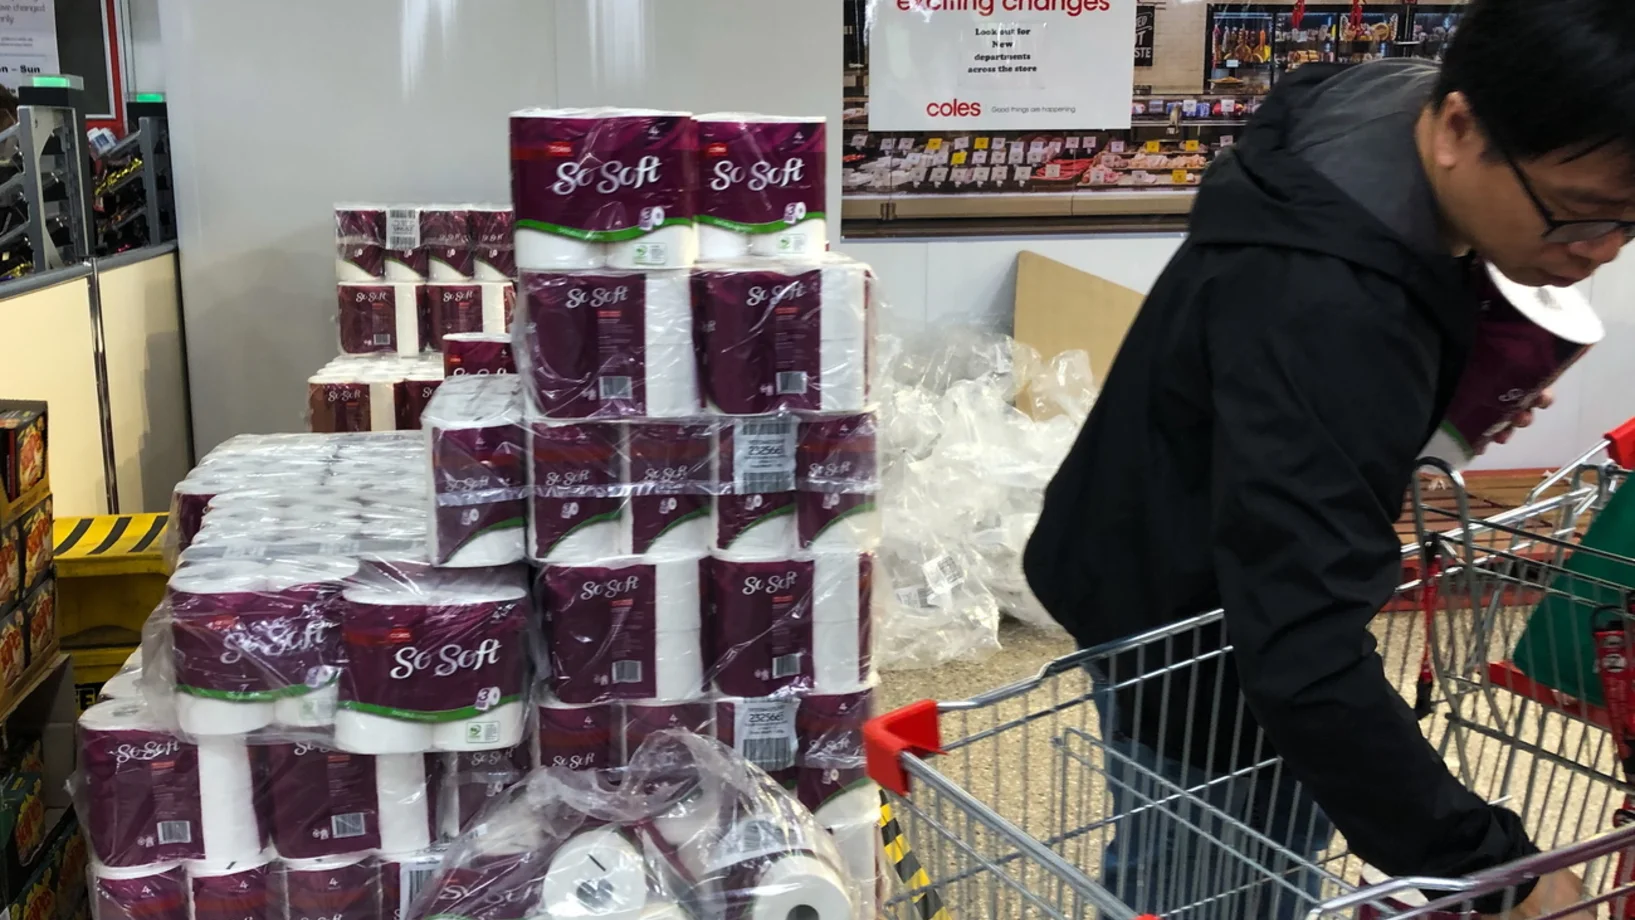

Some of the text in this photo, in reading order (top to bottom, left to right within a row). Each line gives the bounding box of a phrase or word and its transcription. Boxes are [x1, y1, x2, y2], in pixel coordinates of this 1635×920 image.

[975, 28, 997, 36] Look
[1017, 28, 1031, 36] for
[992, 40, 1013, 48] New
[974, 54, 1031, 62] departments
[20, 64, 41, 74] Sun
[926, 98, 981, 117] coles
[552, 155, 662, 196] So Soft
[710, 157, 805, 192] So Soft
[565, 285, 630, 308] So Soft
[746, 286, 768, 306] So
[580, 576, 640, 600] So Soft
[742, 571, 798, 596] So Soft
[390, 638, 502, 680] So Soft
[552, 752, 596, 769] So Soft
